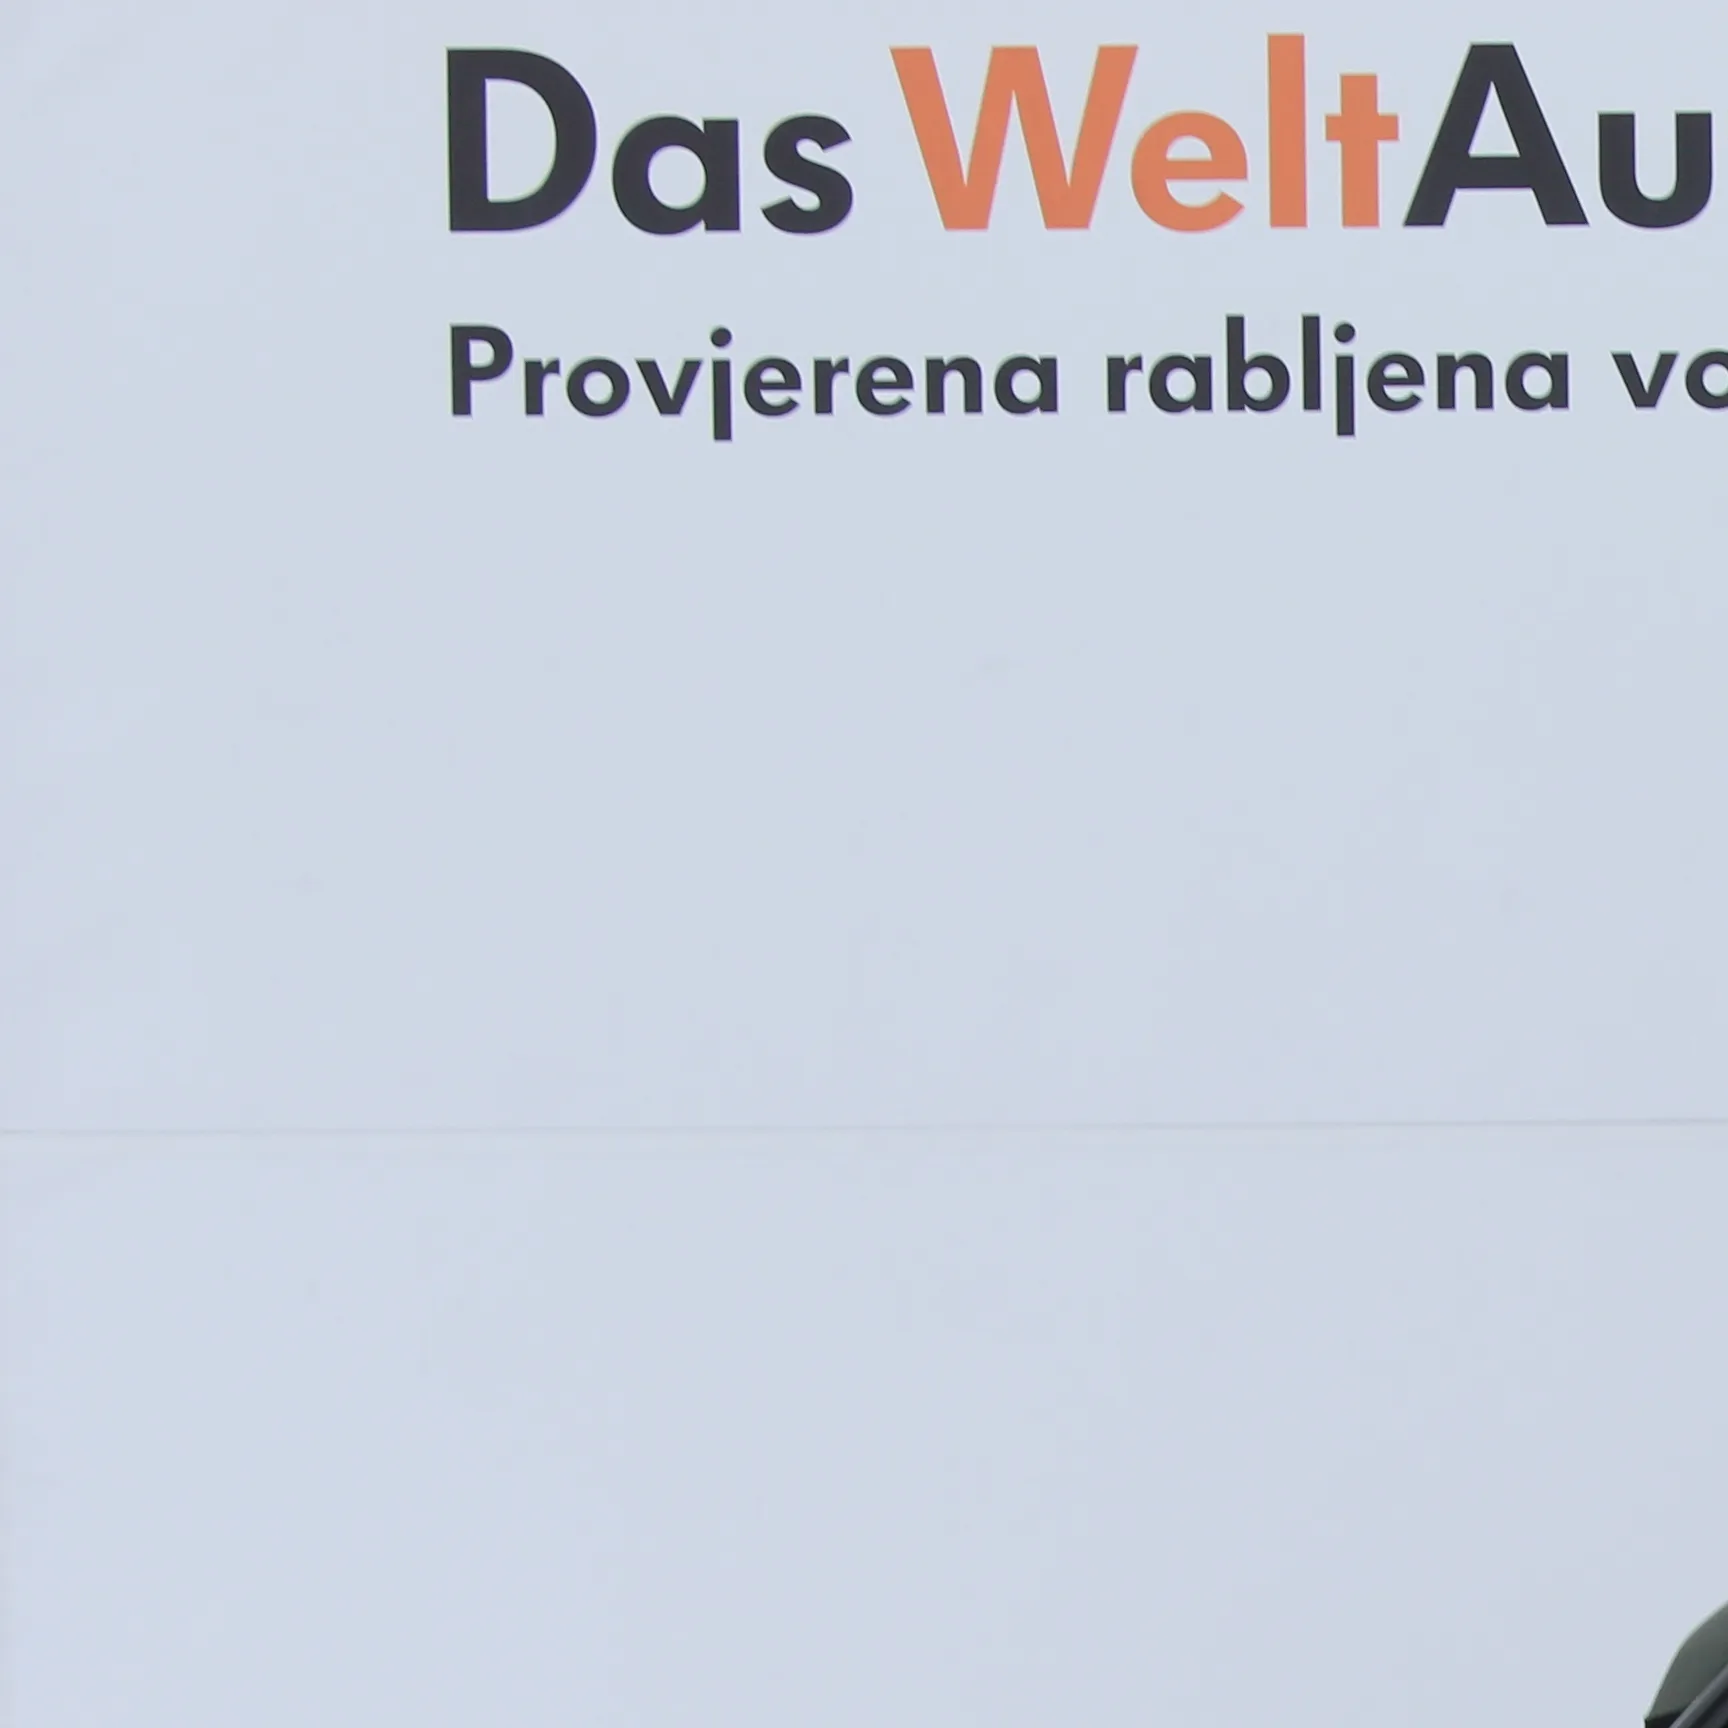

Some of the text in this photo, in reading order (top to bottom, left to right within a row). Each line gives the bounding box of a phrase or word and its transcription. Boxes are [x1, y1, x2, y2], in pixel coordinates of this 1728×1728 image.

[446, 48, 853, 236] Das
[450, 324, 1059, 442] Provjerena
[1106, 314, 1570, 437] rabljena
